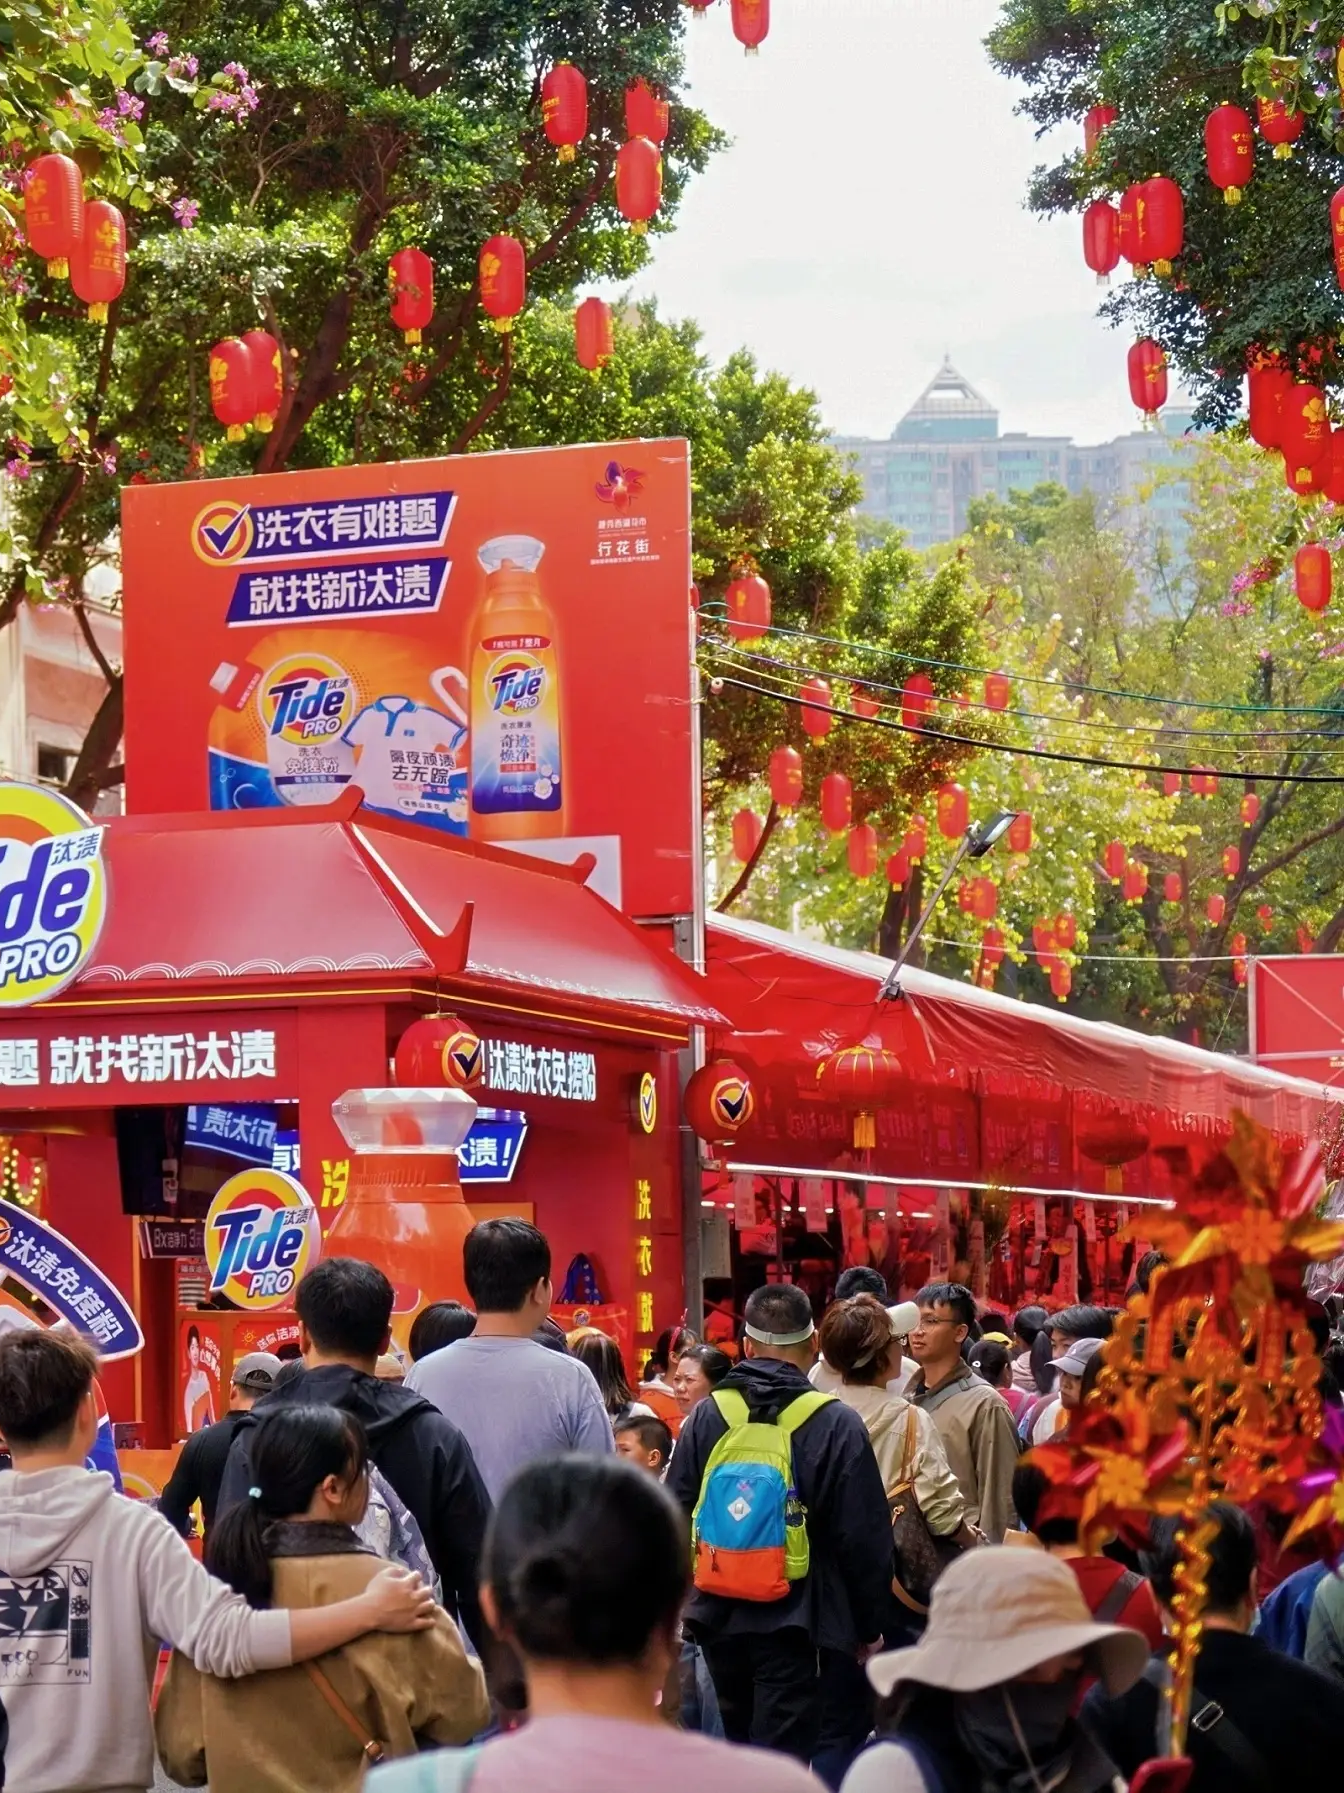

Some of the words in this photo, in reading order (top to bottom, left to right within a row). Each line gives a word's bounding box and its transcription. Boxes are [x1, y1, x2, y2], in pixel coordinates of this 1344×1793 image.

[256, 499, 438, 549] 洗衣有难题
[598, 538, 649, 557] 行花街
[249, 564, 432, 616] 就找新汰渍
[491, 670, 542, 711] Tide
[514, 696, 539, 711] PRO
[268, 680, 346, 735] Tide
[302, 717, 342, 739] PRO
[390, 750, 455, 767] 隔夜顽渍
[392, 765, 449, 784] 去无踪
[51, 832, 100, 866] 汰渍
[50, 1030, 276, 1085] 就找新汰渍
[284, 1207, 310, 1226] 汰渍
[214, 1204, 303, 1289] Tide
[4, 1230, 124, 1344] 汰渍免搓粉
[248, 1269, 295, 1297] PRO
[67, 1669, 89, 1677] FUN
